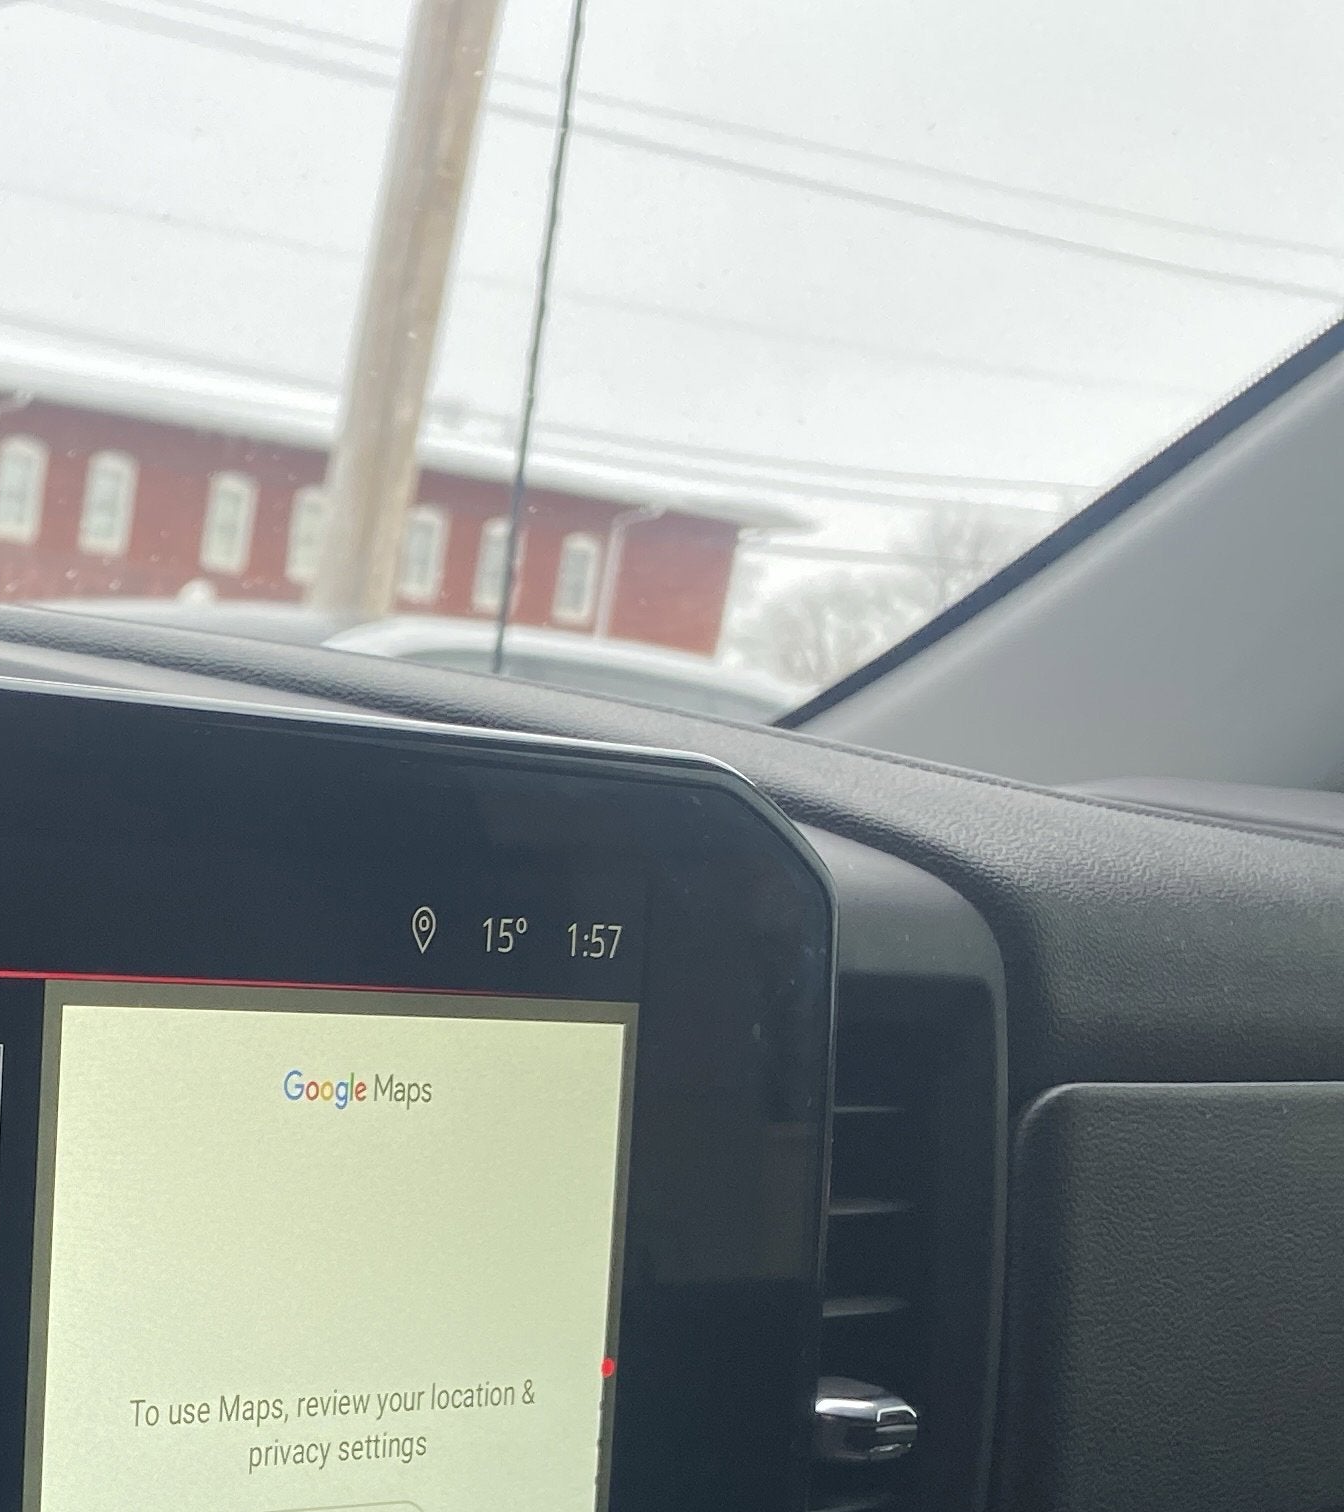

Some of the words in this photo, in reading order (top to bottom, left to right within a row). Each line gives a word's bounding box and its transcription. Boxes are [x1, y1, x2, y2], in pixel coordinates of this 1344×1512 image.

[567, 922, 623, 959] 1:57
[283, 1069, 367, 1110] Google
[373, 1073, 433, 1111] Maps
[129, 1399, 160, 1427] To
[168, 1400, 211, 1425] use
[218, 1394, 289, 1427] Maps,
[296, 1388, 370, 1419] review
[375, 1390, 426, 1421] your
[430, 1381, 516, 1410] location
[521, 1379, 537, 1406] &
[248, 1438, 332, 1476] privacy
[337, 1431, 428, 1465] settings
